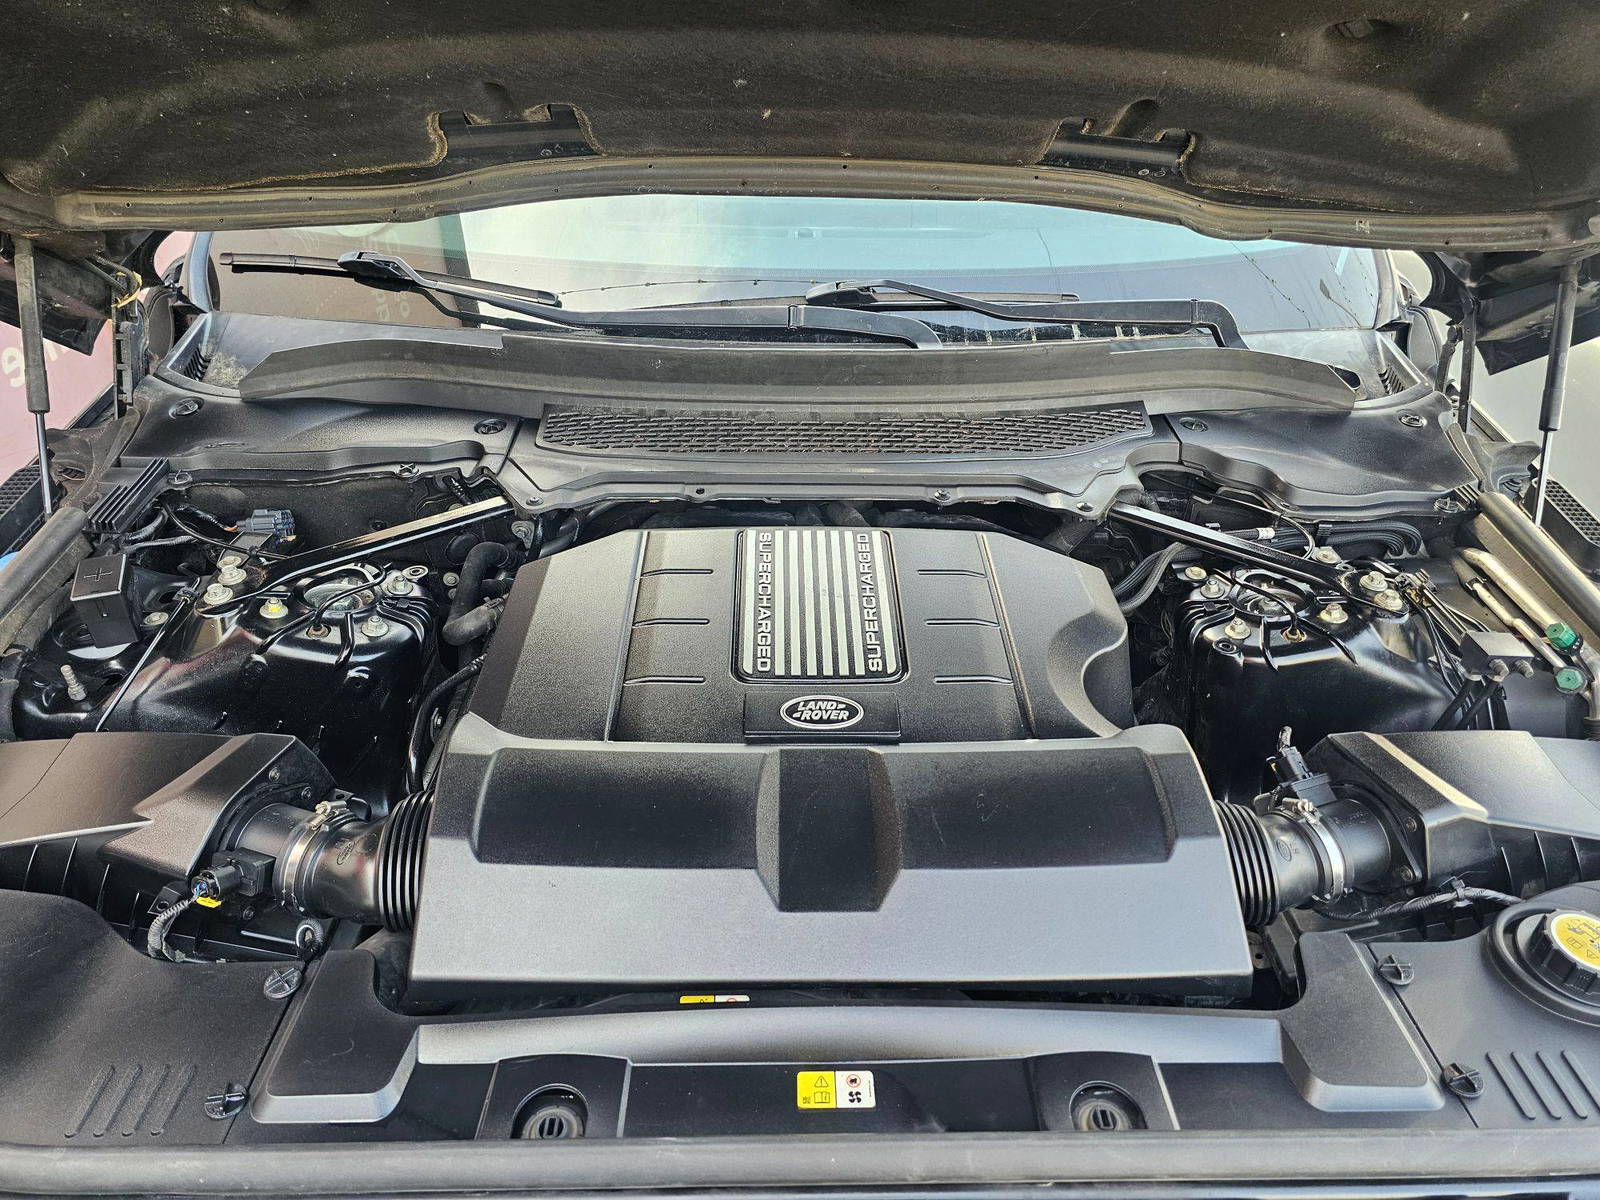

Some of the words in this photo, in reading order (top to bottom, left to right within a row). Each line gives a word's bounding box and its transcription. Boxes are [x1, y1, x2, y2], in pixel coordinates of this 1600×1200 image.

[757, 532, 772, 672] SUPERCHARGED
[857, 533, 883, 672] SUPERCHARGED
[797, 701, 838, 711] LAND
[800, 710, 850, 720] ROVER
